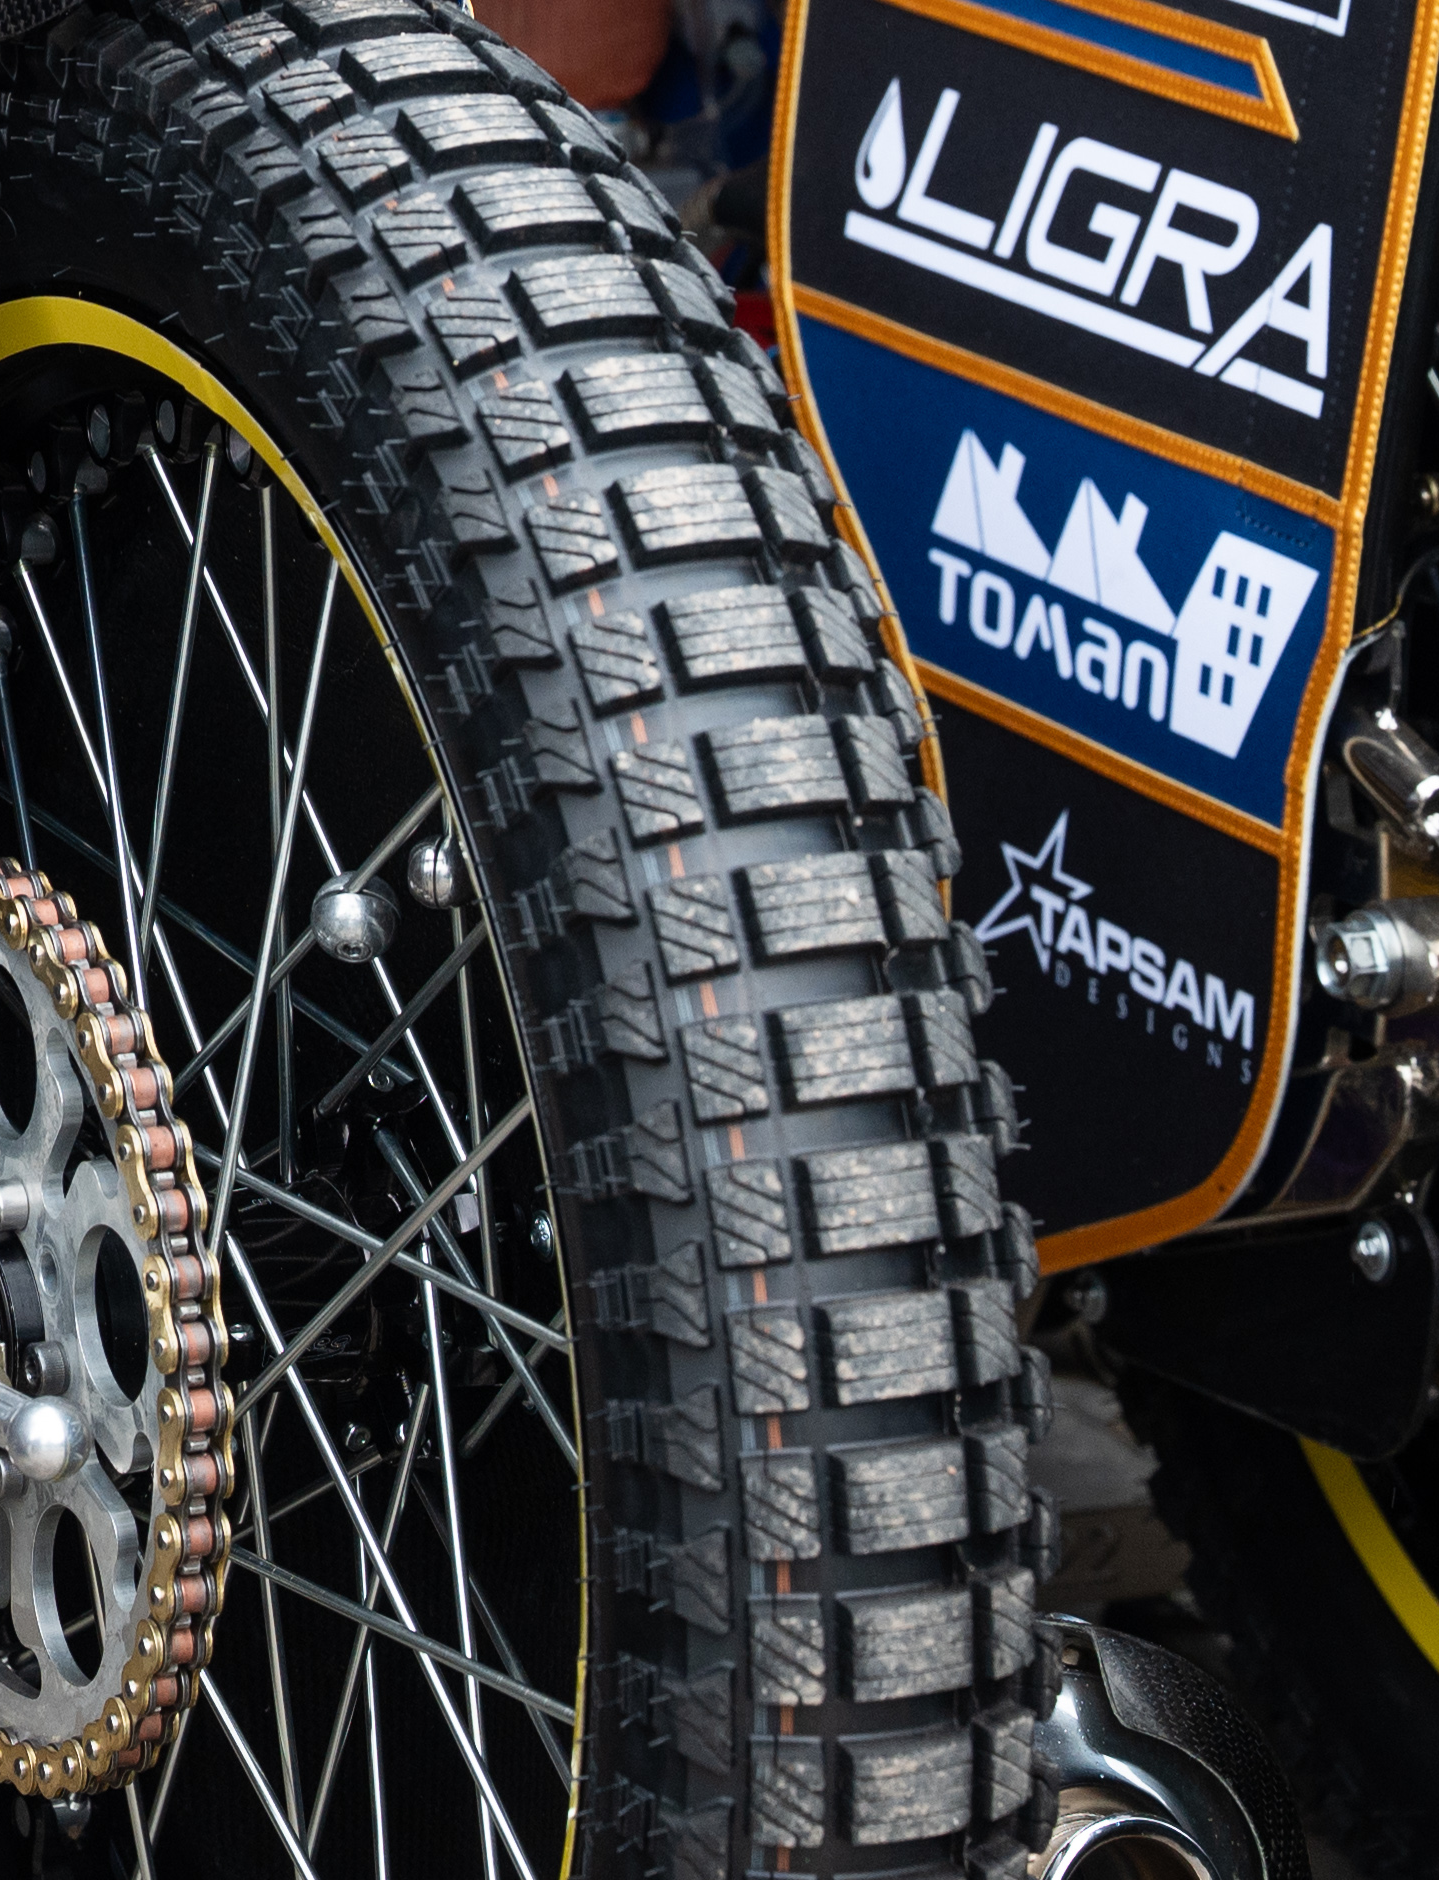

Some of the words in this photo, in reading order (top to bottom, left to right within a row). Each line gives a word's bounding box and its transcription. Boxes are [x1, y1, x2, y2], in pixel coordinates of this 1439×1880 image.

[897, 87, 1333, 379] LIGRA
[1030, 883, 1255, 1052] TAPSAM
[1054, 959, 1253, 1085] DESIGNS
